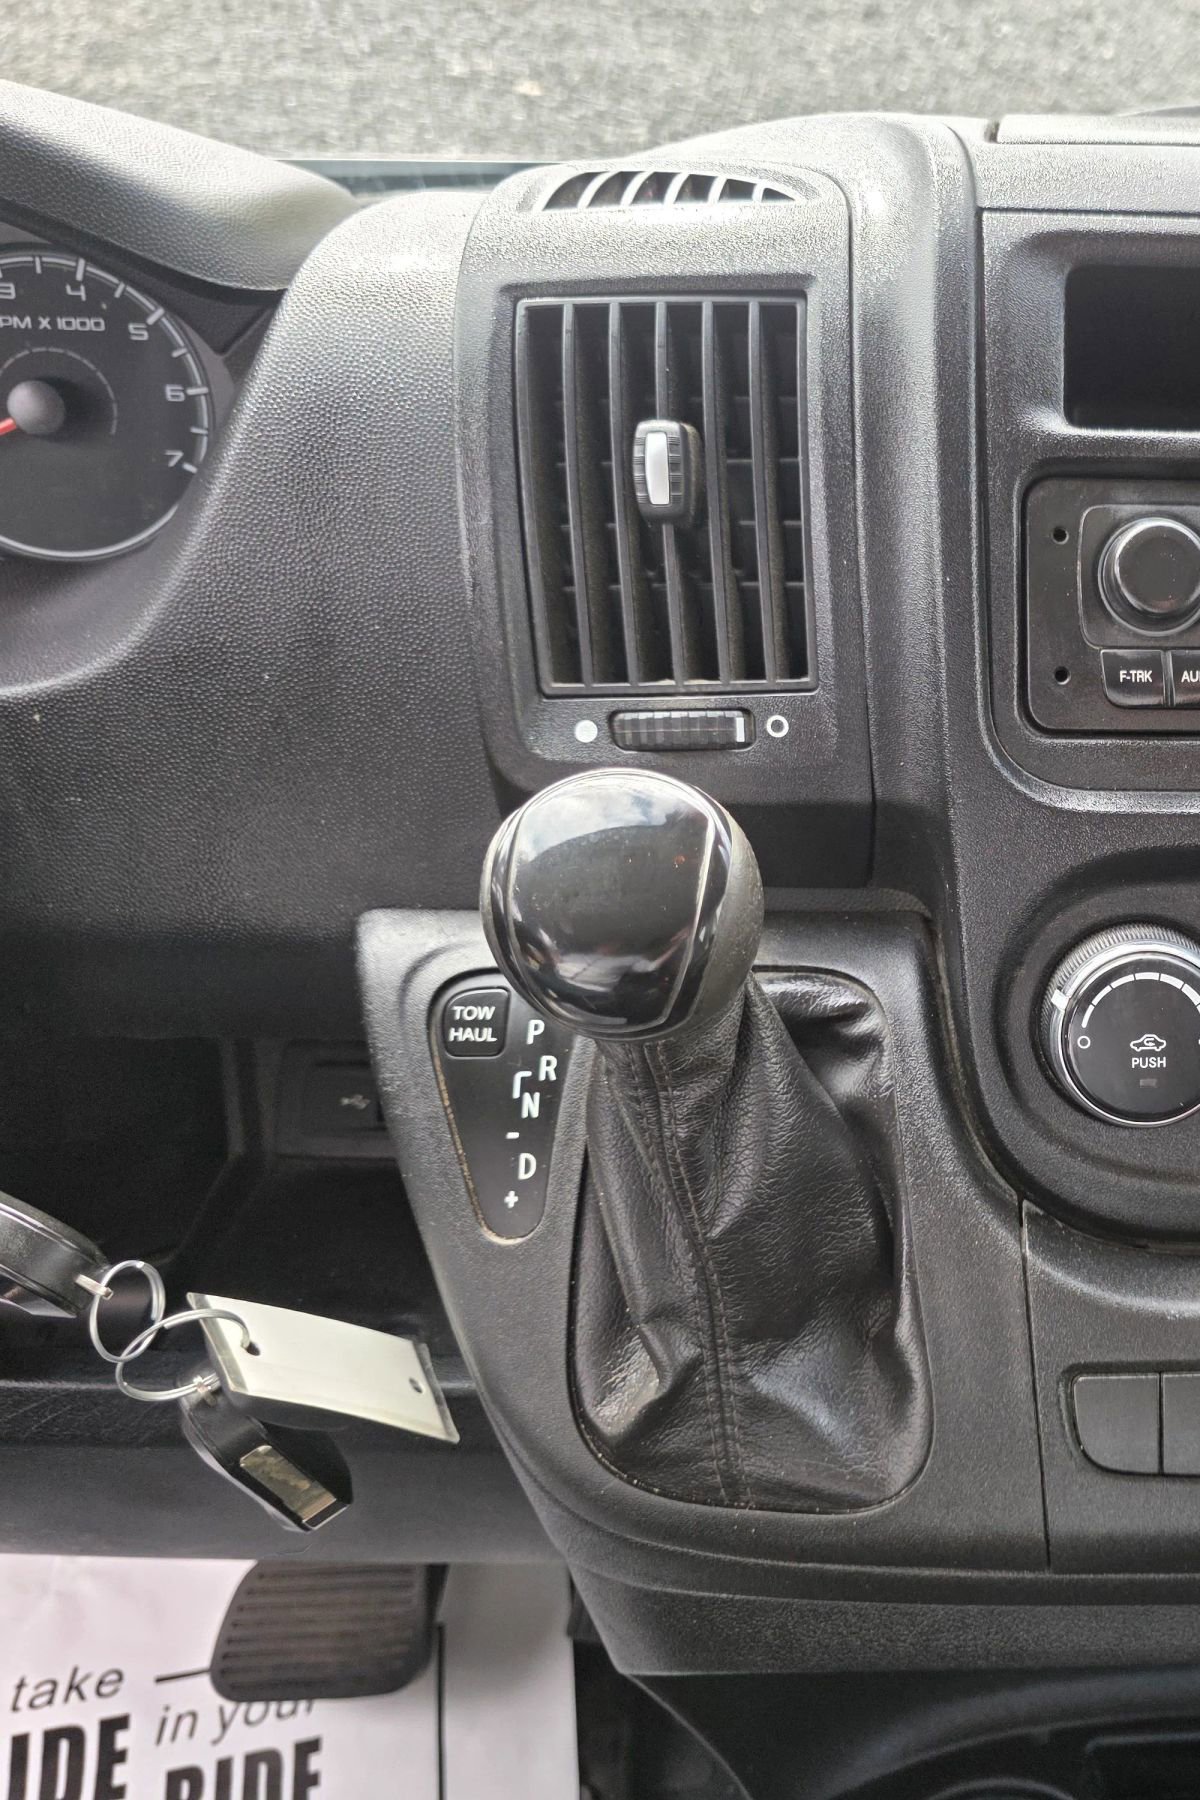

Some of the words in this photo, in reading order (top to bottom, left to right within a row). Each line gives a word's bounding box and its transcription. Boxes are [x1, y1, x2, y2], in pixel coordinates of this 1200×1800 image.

[65, 283, 87, 302] 4
[38, 316, 52, 330] X
[57, 316, 105, 332] 1000
[128, 322, 149, 341] 5
[165, 384, 186, 402] 6
[165, 450, 184, 467] 7
[1119, 669, 1153, 683] F-TRK
[452, 1005, 496, 1021] TOW
[449, 1027, 498, 1043] HAUL
[526, 1019, 545, 1045] P
[538, 1055, 558, 1081] R
[1131, 1056, 1166, 1069] PUSH
[521, 1091, 541, 1119] N
[517, 1152, 537, 1180] D
[10, 1666, 125, 1713] take
[155, 1704, 198, 1746] in
